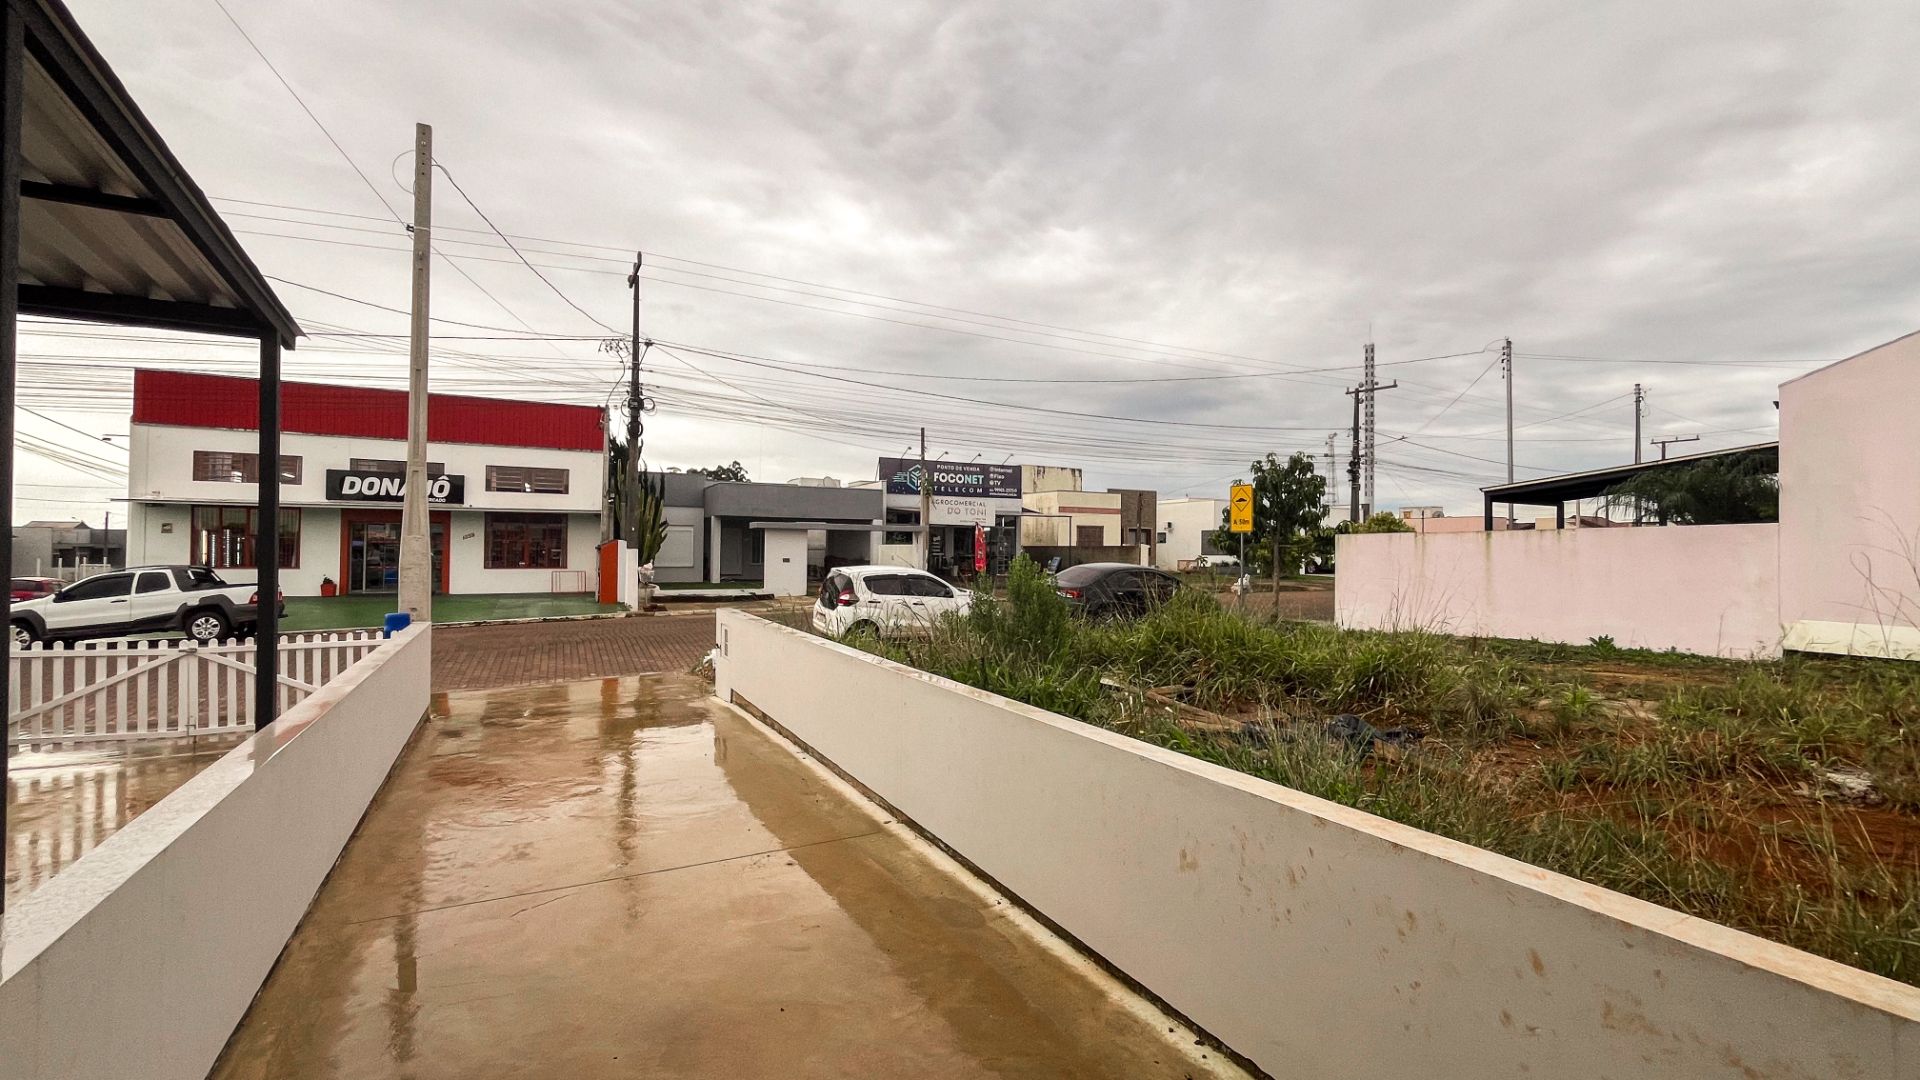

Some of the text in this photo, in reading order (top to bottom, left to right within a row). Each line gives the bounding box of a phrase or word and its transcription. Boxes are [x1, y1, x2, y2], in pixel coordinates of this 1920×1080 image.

[933, 472, 984, 484] FOCONET
[947, 507, 987, 516] DO TONI
